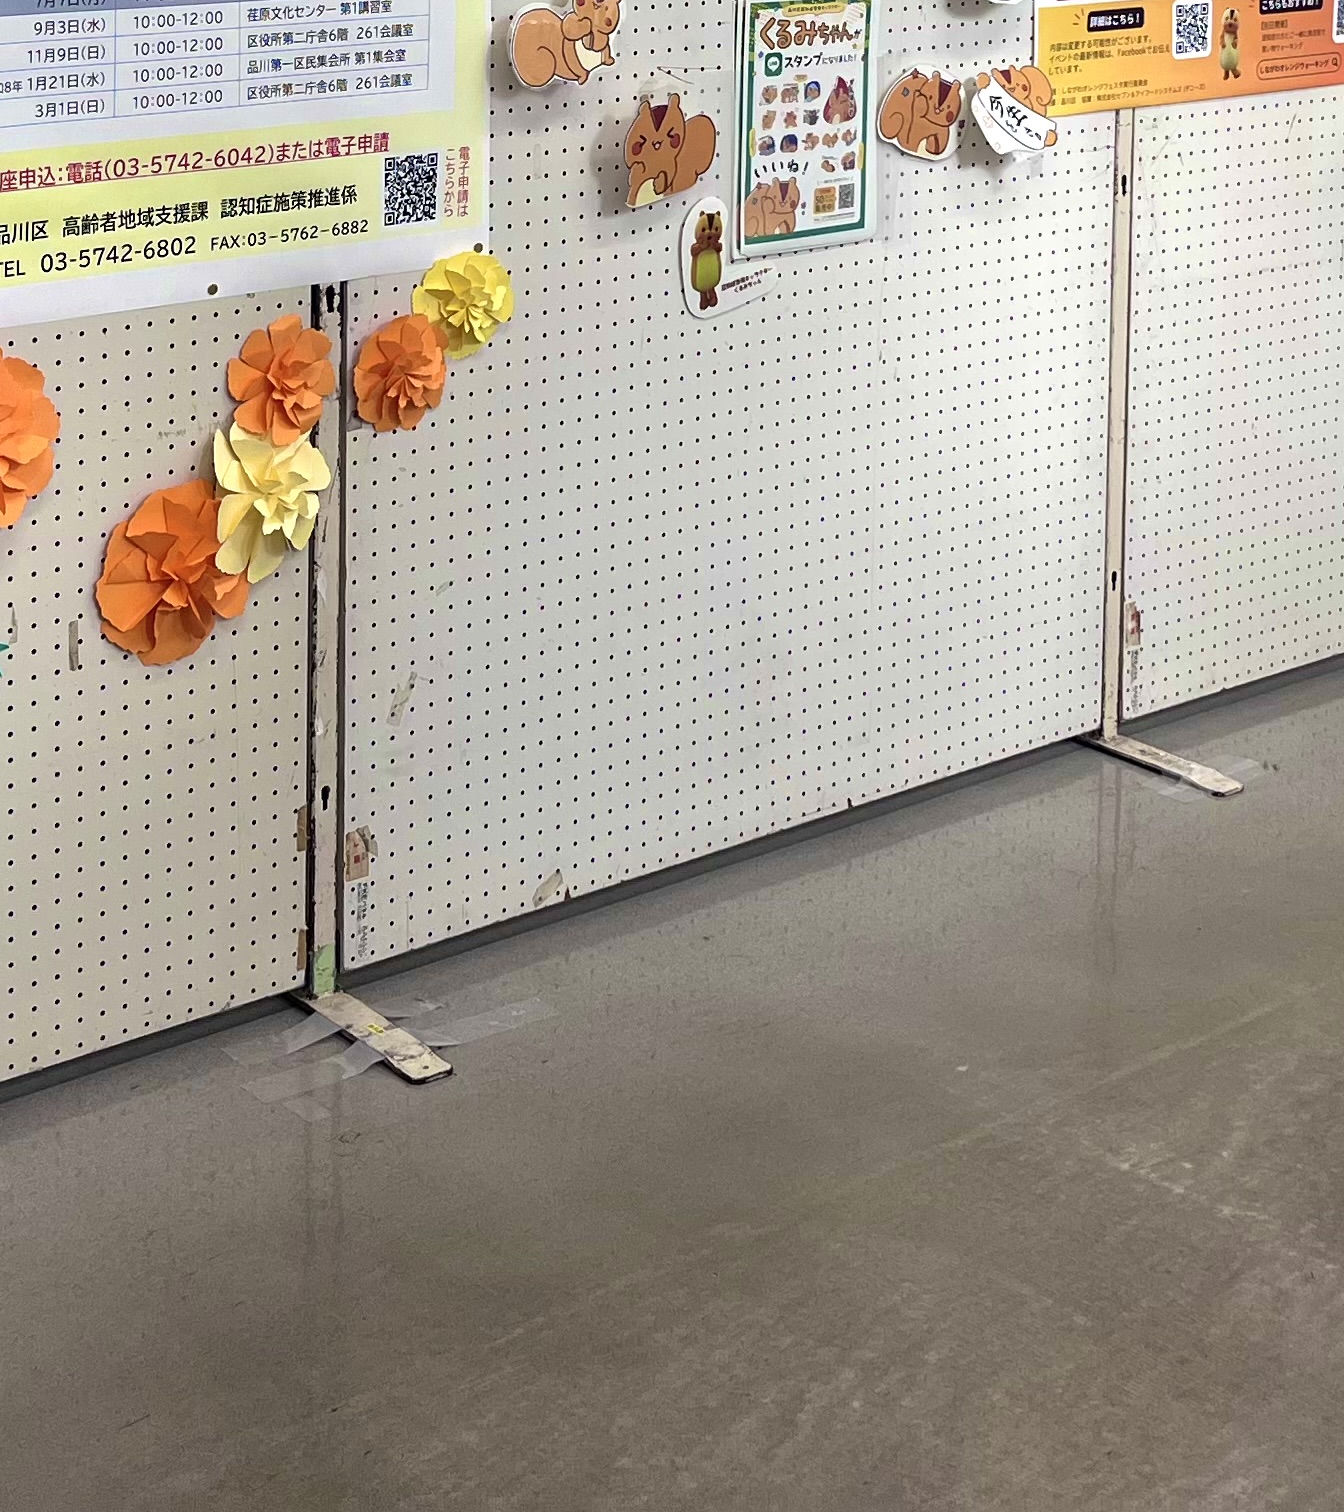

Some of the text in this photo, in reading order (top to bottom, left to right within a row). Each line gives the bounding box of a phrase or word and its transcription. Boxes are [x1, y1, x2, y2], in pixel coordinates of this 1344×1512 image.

[759, 16, 863, 49] くるみちゃんが
[1090, 12, 1141, 28] 詳細はこちら!
[784, 52, 857, 69] スタンプになりました!
[443, 148, 456, 217] こちらから
[457, 146, 471, 217] 電子申請は
[62, 200, 209, 238] 高齢者地域支援課
[220, 185, 357, 219] 認知症施策推進係
[40, 236, 196, 273] 03-5742-6802
[210, 219, 369, 252] FAX:03-5762-6882
